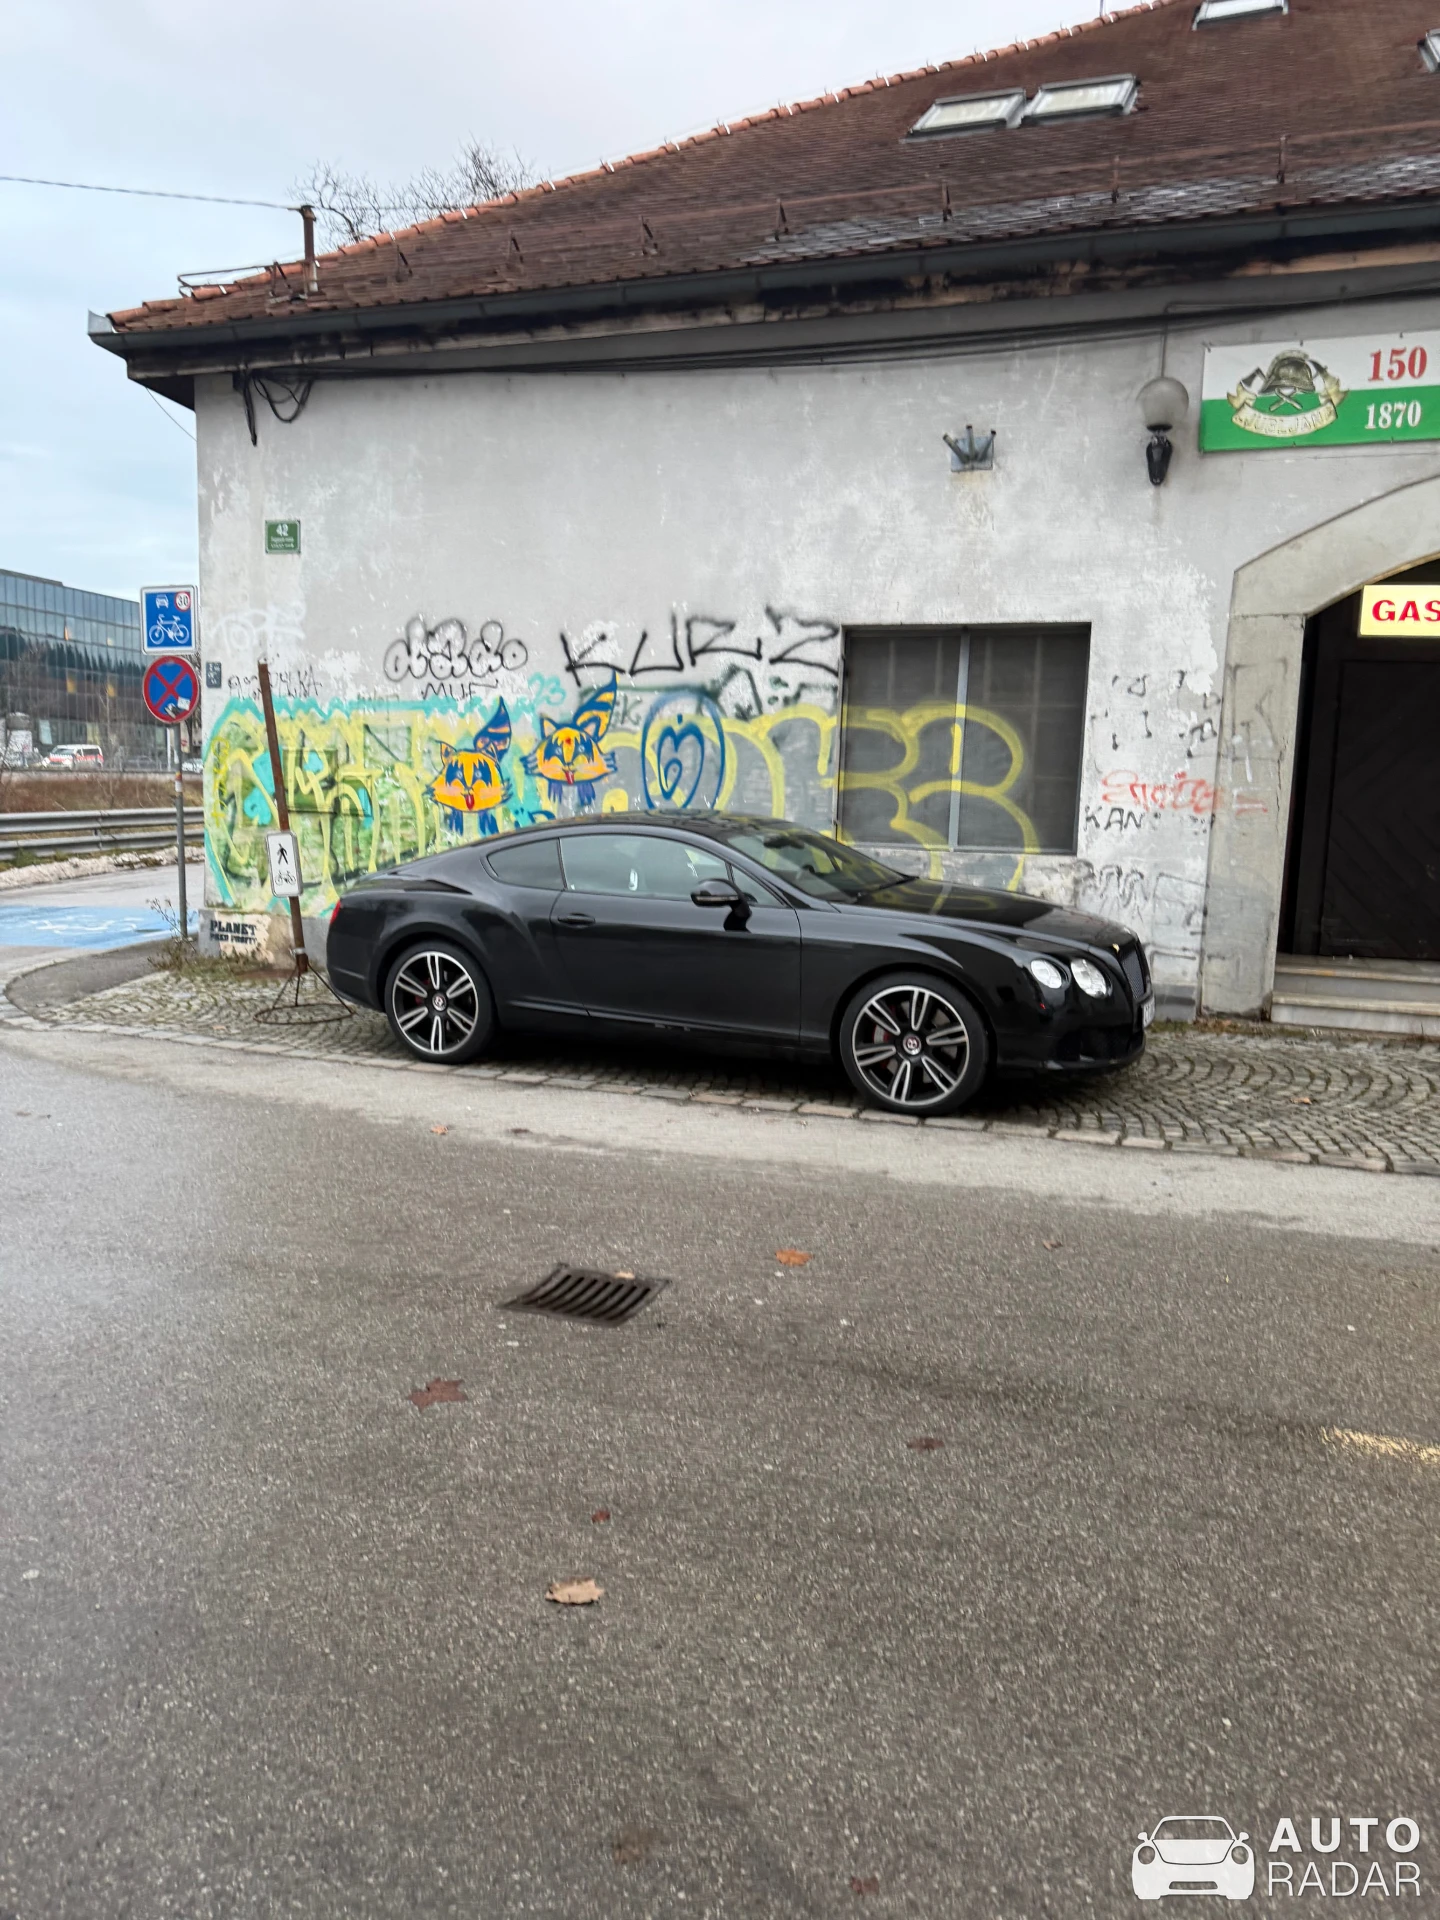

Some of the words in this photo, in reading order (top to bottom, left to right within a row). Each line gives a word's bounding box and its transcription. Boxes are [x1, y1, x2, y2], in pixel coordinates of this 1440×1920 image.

[1367, 345, 1428, 382] 150
[1364, 400, 1422, 430] 1870
[178, 595, 189, 607] 30
[210, 920, 257, 936] PLANET
